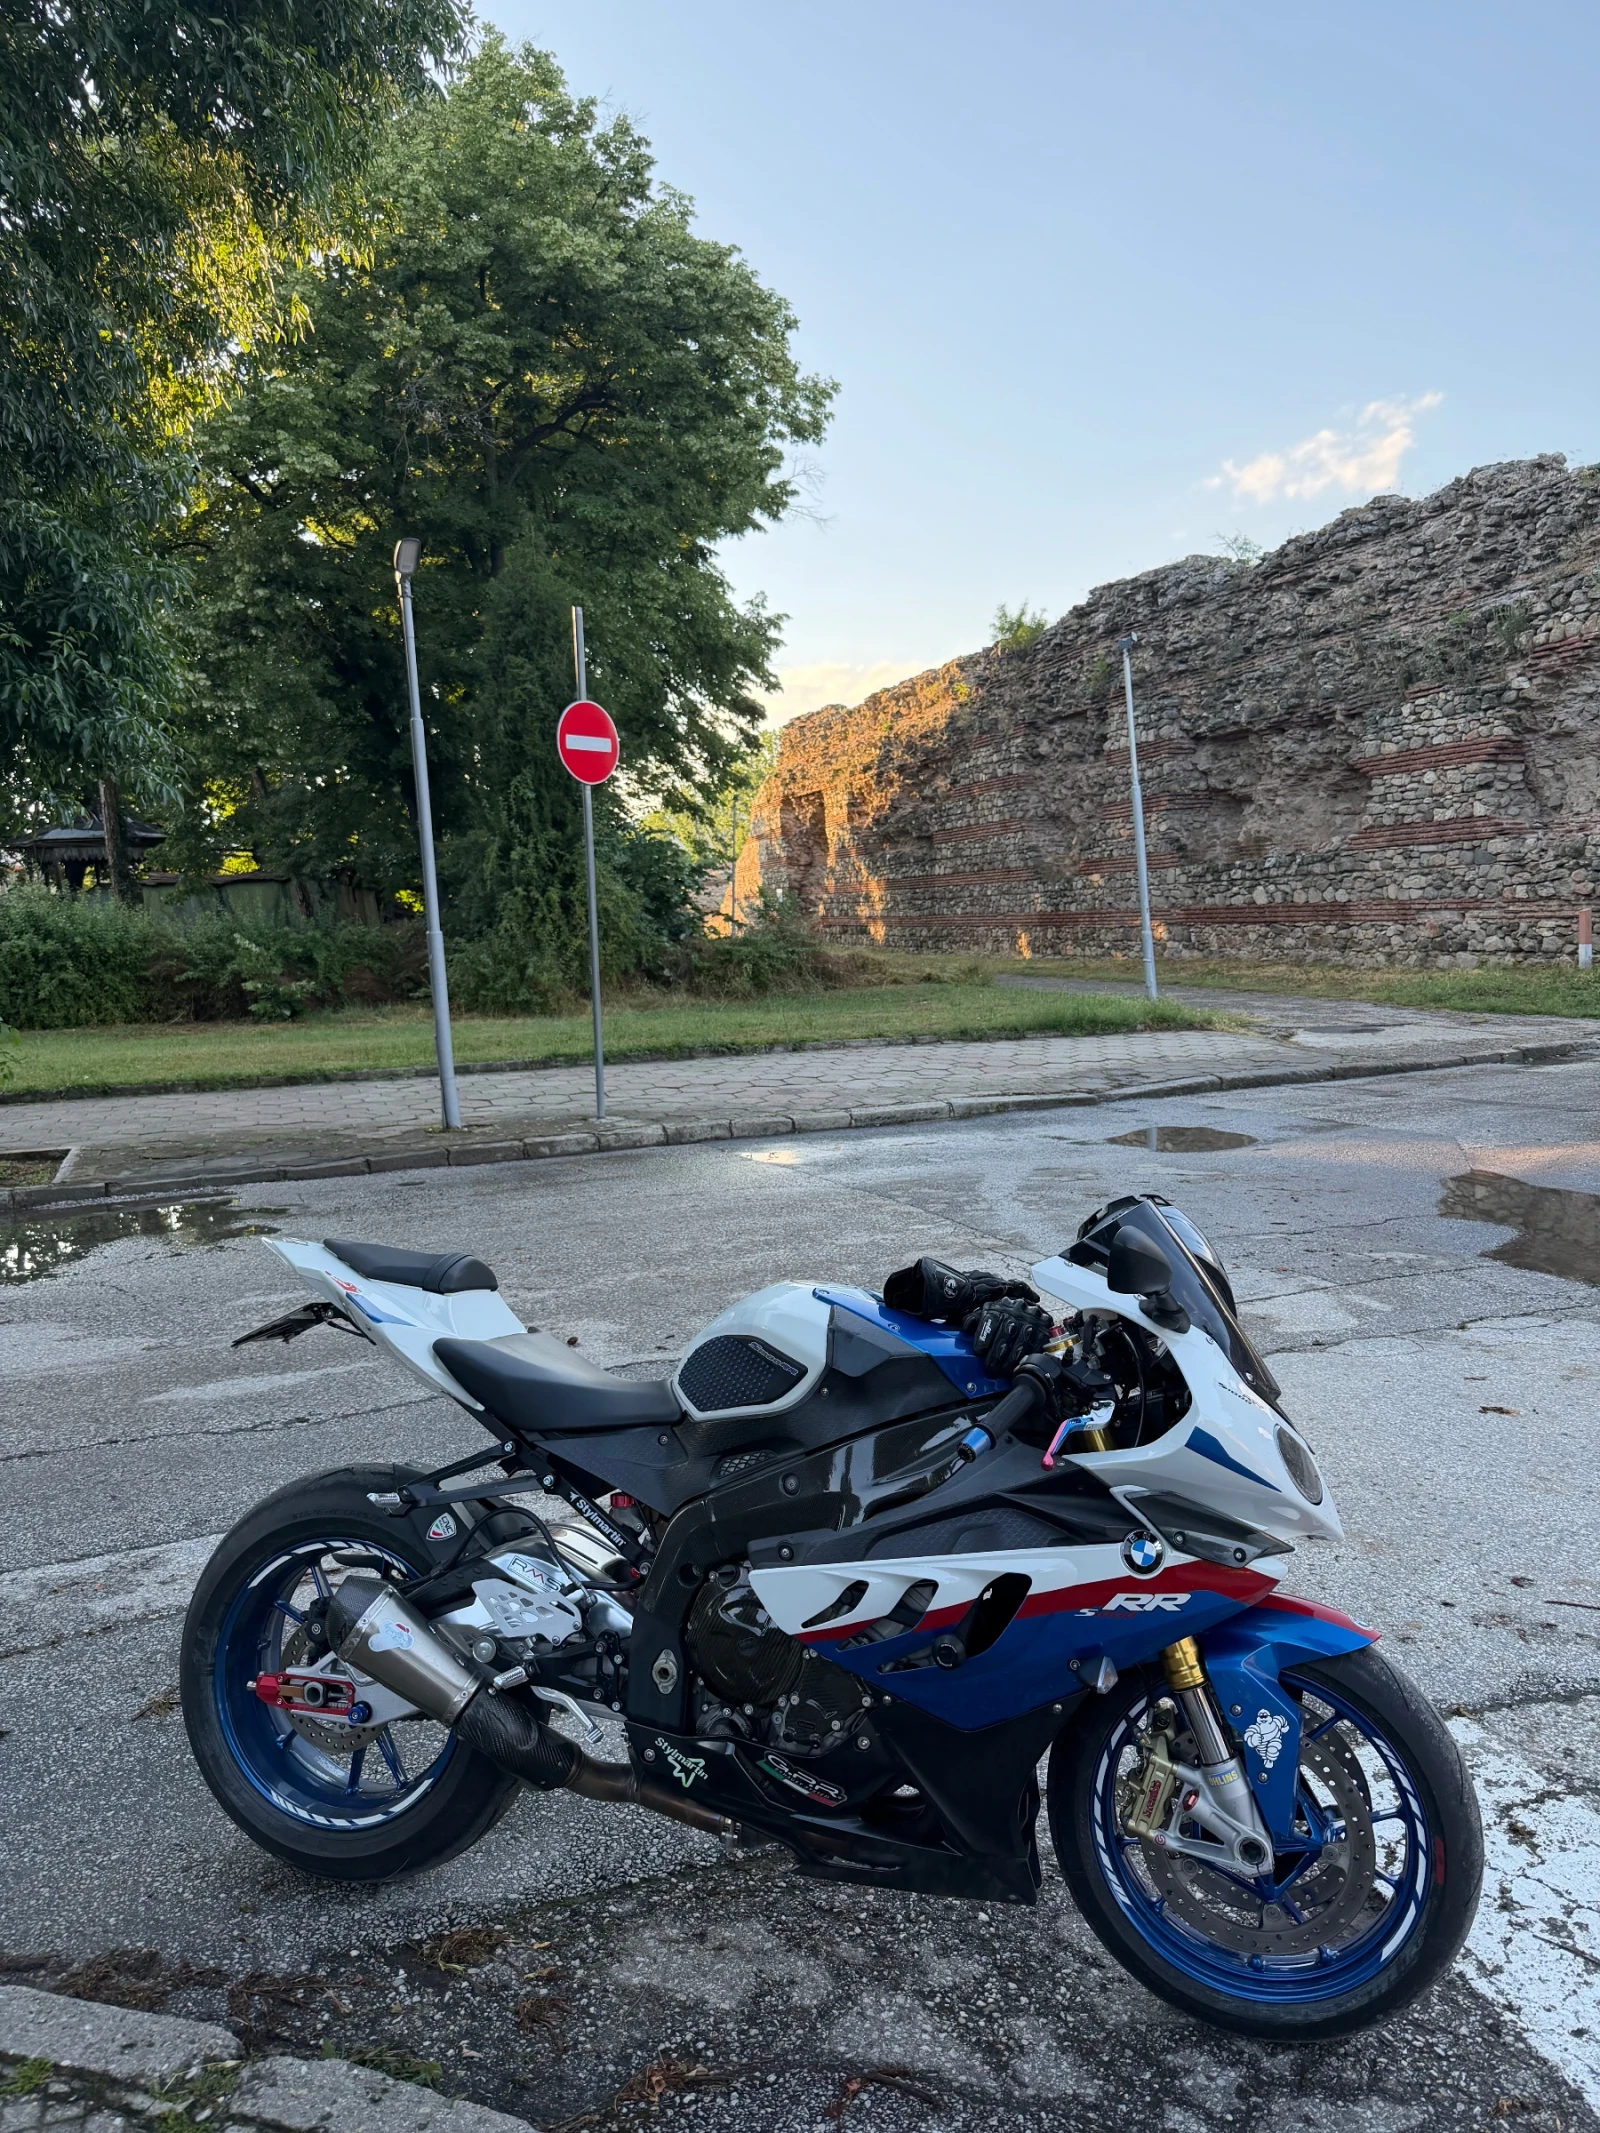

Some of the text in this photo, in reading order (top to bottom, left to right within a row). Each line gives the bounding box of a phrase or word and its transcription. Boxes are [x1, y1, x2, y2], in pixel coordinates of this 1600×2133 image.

[576, 1499, 625, 1547] Stylmartin
[511, 1557, 560, 1591] RMS
[1101, 1593, 1192, 1612] RR
[654, 1737, 709, 1780] Stylmartin
